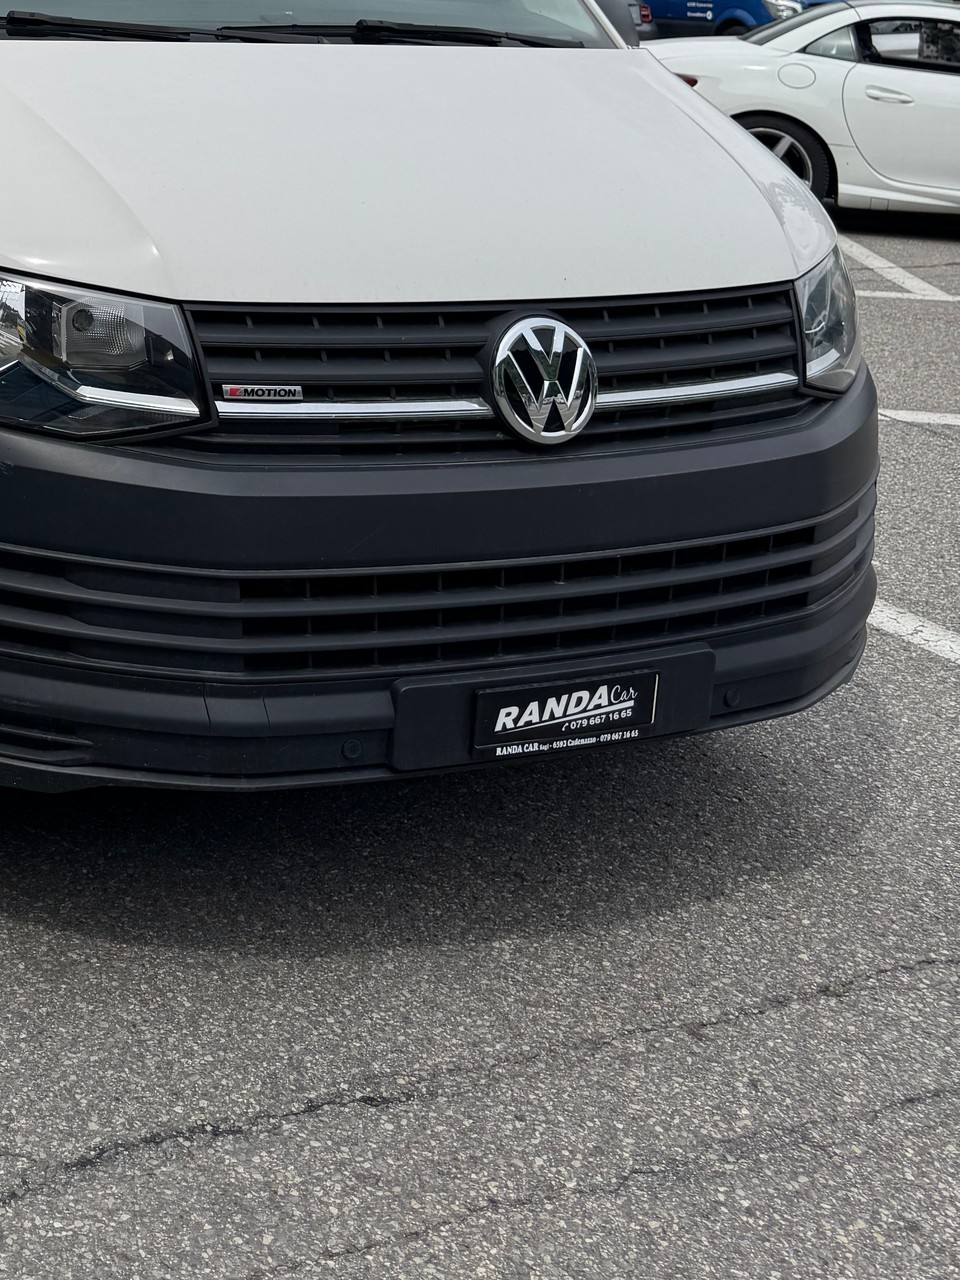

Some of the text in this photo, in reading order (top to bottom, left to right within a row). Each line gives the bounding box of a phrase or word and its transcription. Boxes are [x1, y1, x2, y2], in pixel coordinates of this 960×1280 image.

[494, 684, 639, 732] RANDA Car
[570, 708, 632, 730] 079 667 16 65
[495, 745, 523, 756] RANDA
[523, 742, 539, 753] CAR
[552, 740, 567, 749] 6593
[600, 734, 611, 742] 079
[611, 732, 623, 741] 667
[623, 730, 631, 739] 16
[631, 729, 639, 737] 65
